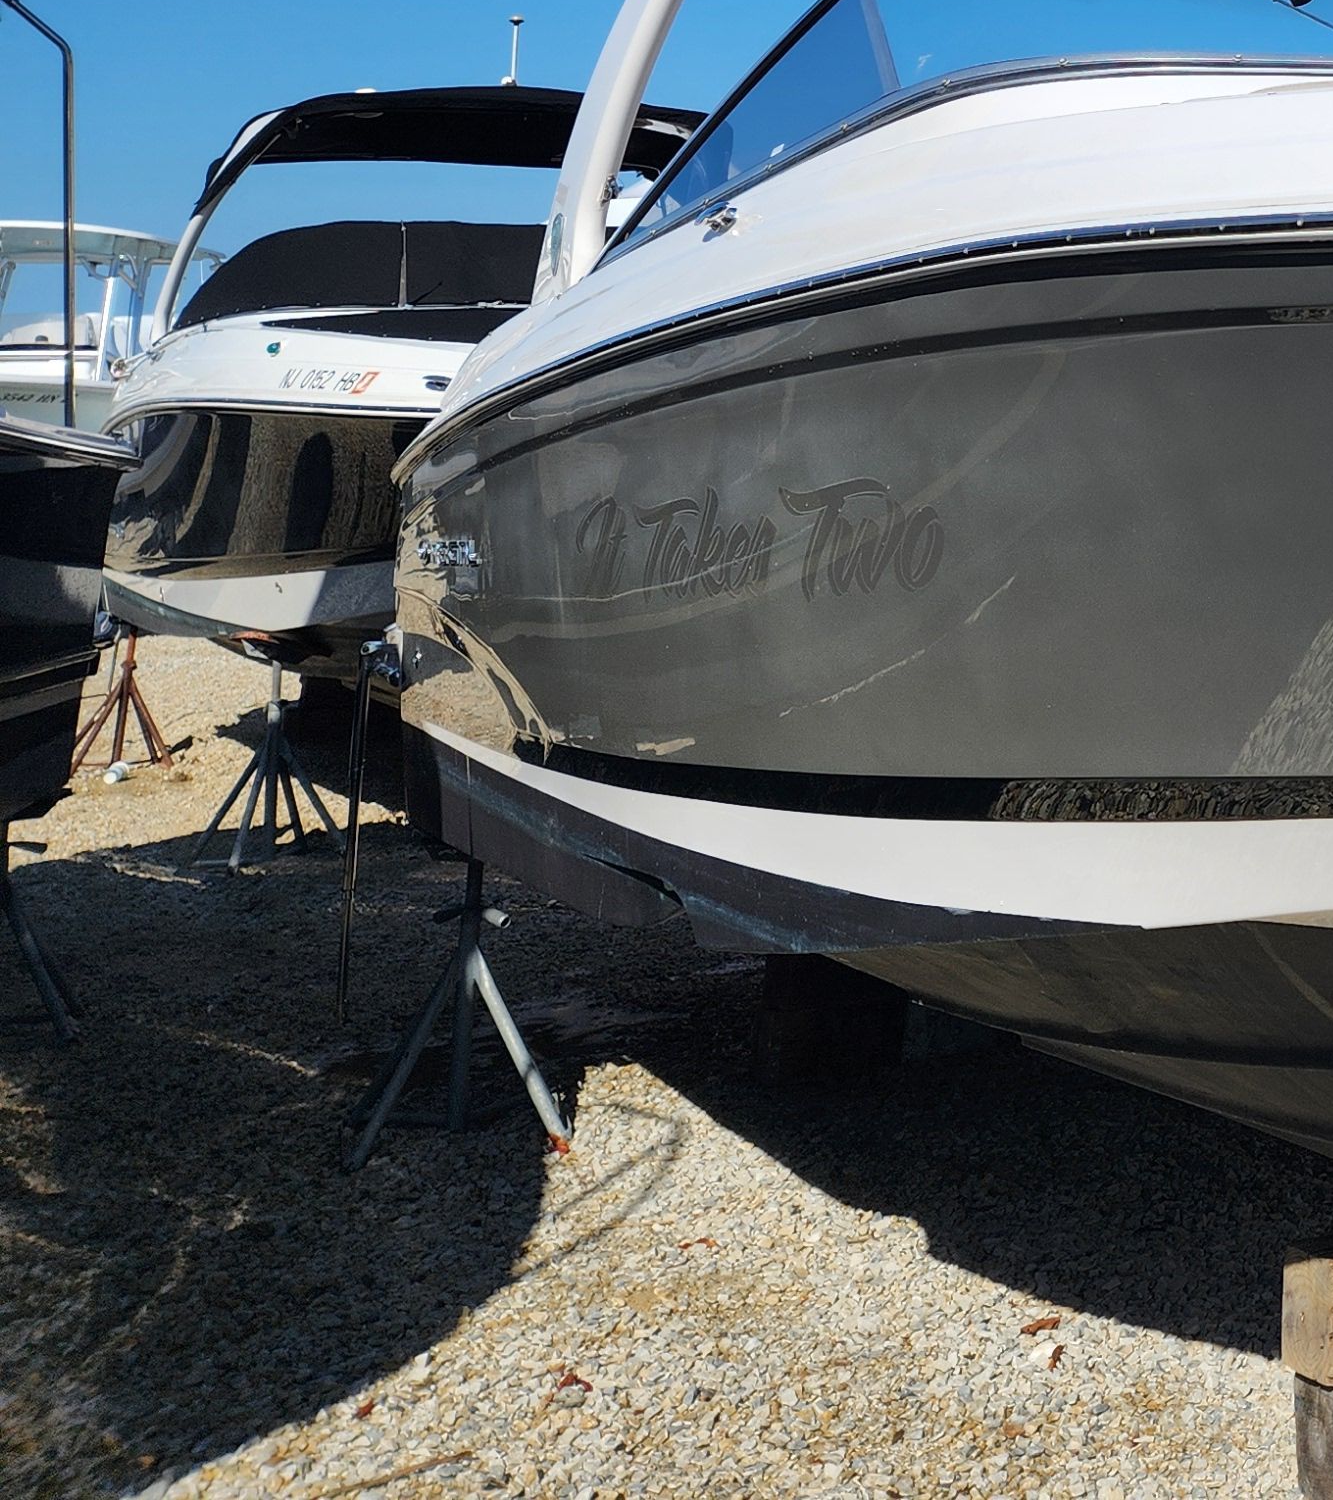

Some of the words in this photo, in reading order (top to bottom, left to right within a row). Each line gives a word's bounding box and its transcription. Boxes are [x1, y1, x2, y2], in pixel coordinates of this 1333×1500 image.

[279, 368, 302, 388] NJ
[300, 369, 336, 390] 0152
[632, 484, 778, 603] Takes
[778, 476, 945, 602] Two
